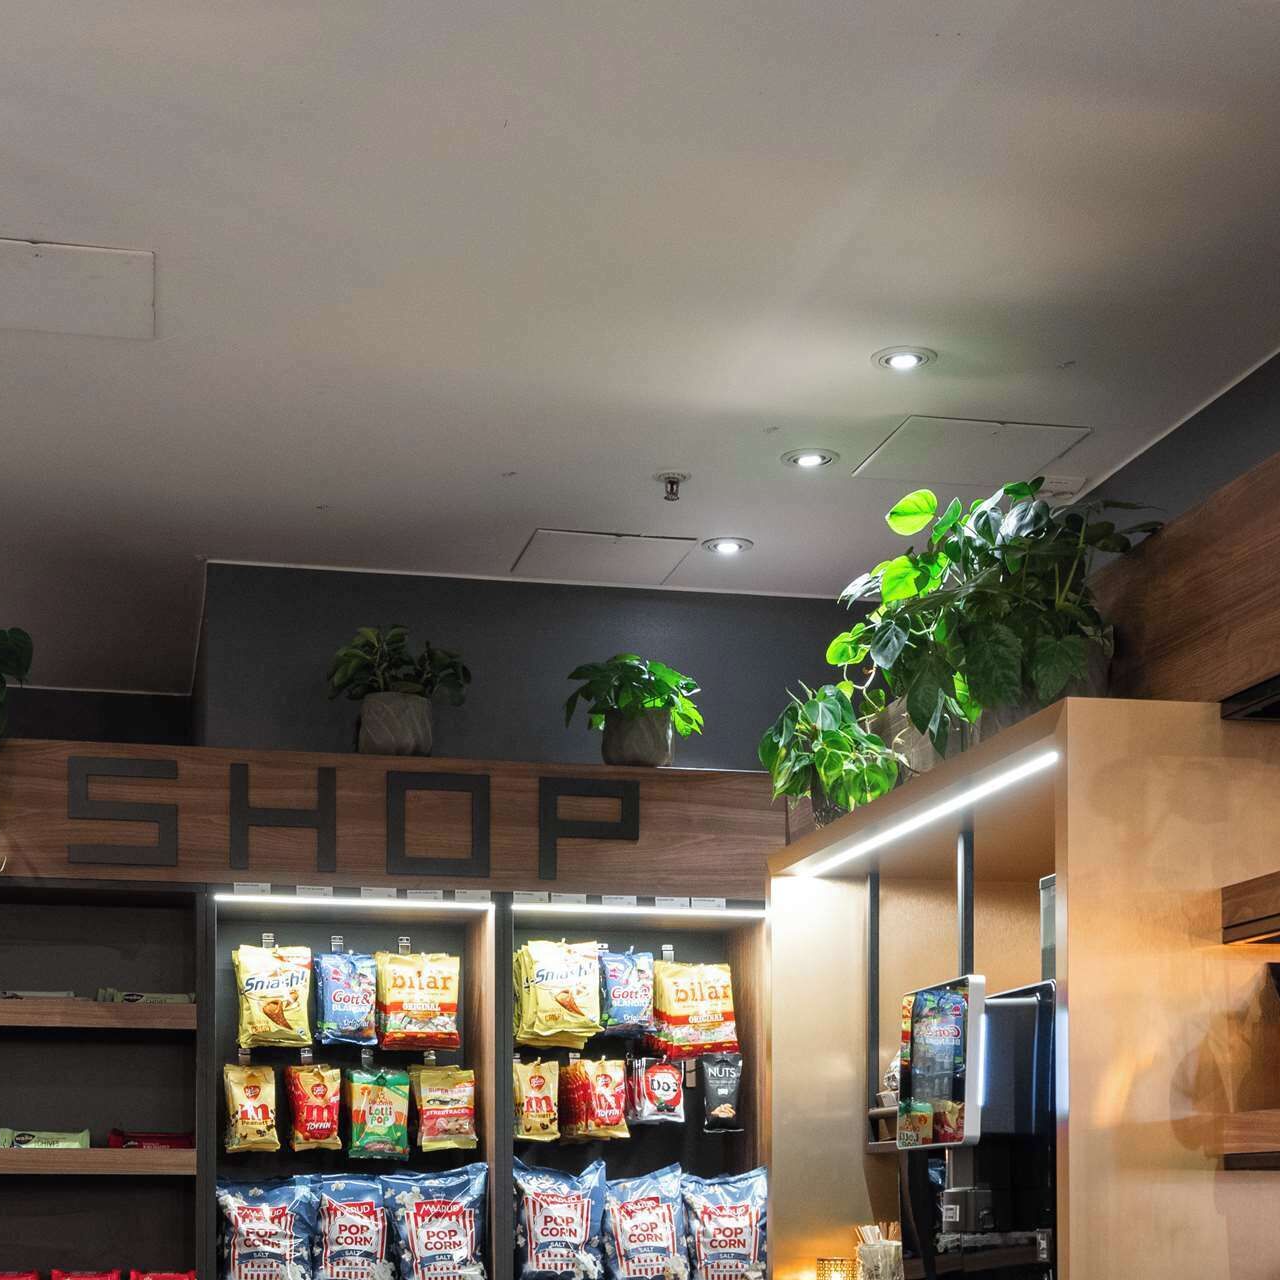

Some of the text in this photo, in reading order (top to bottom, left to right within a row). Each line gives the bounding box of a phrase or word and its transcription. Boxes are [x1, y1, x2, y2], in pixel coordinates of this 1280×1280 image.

[67, 756, 639, 880] SHOP
[244, 970, 306, 993] Smash!
[673, 980, 730, 1003] bilar
[688, 1014, 725, 1023] ORIGINAL
[708, 1067, 737, 1078] NUTS
[544, 1215, 575, 1226] POP
[338, 1224, 370, 1235] POP
[426, 1230, 458, 1240] POP
[540, 1227, 577, 1238] CORN
[712, 1227, 744, 1238] POP
[335, 1236, 373, 1247] CORN
[628, 1233, 663, 1243] CORN
[424, 1240, 462, 1251] CORN
[709, 1239, 746, 1249] CORN
